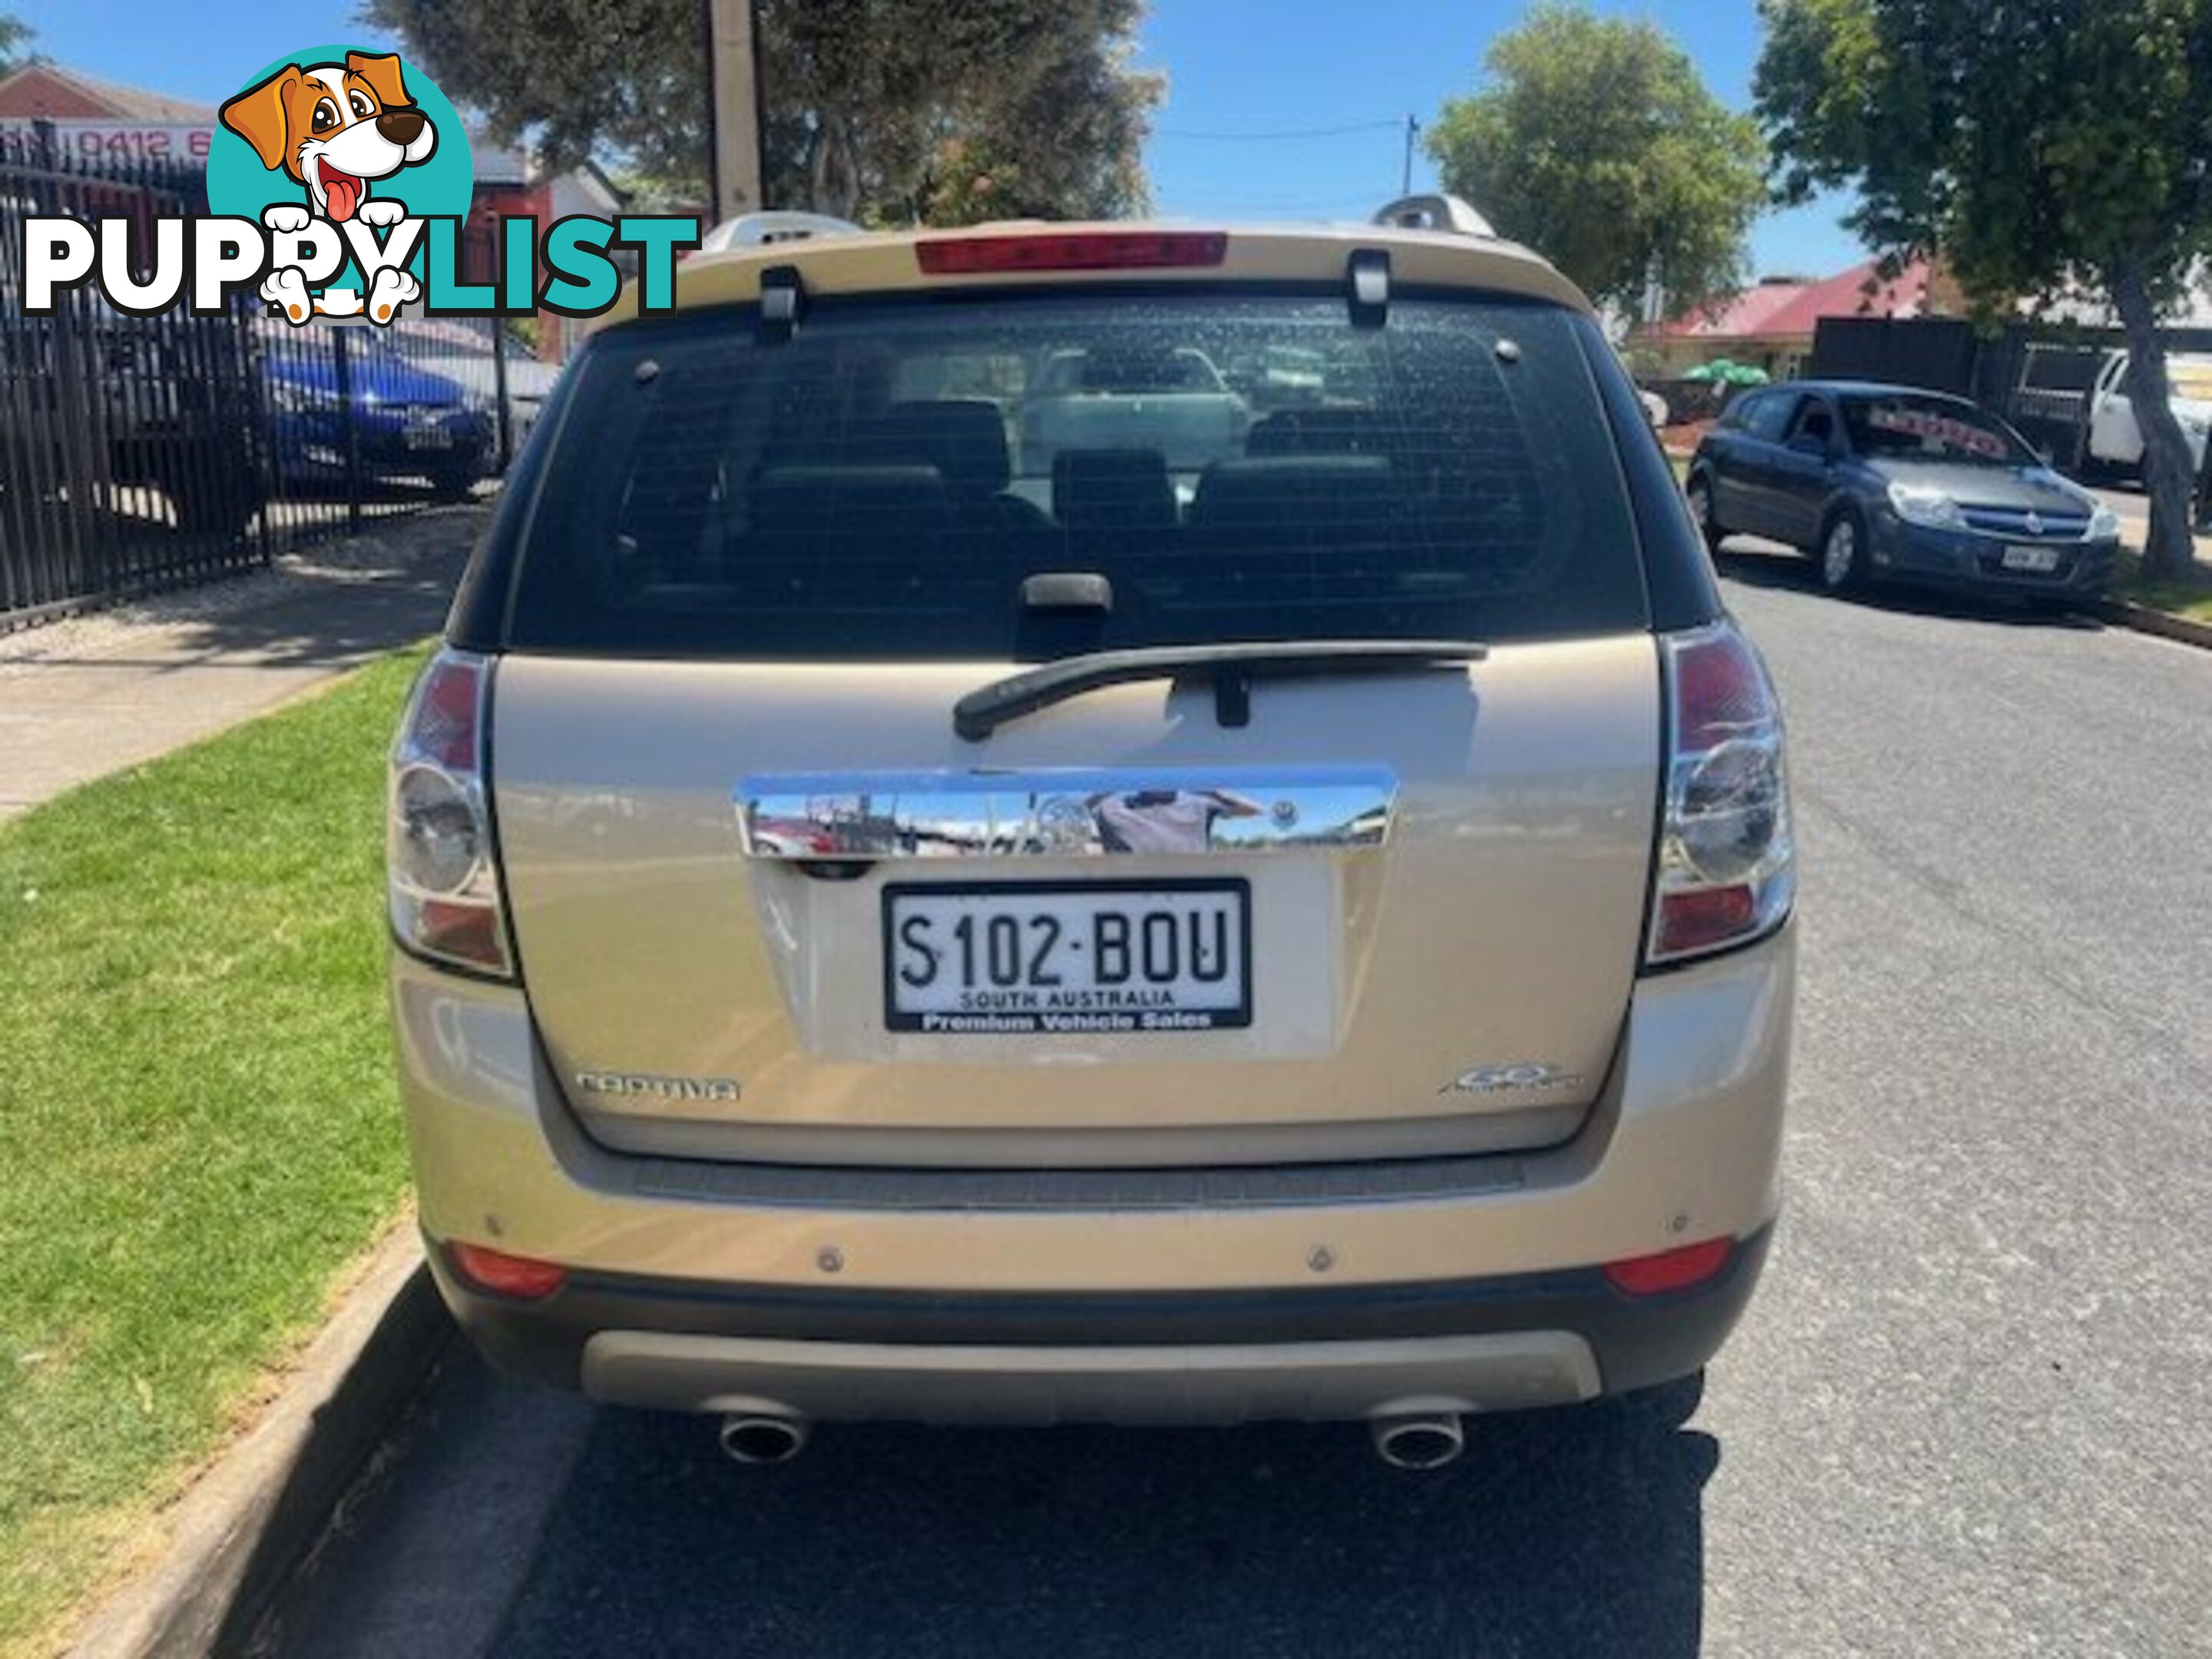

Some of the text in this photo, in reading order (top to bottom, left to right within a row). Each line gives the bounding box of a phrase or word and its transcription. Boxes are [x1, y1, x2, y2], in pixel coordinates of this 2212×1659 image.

[960, 990, 1175, 1008] SOUTH AUSTRALIA
[923, 1011, 1211, 1031] Premium Vehicle Sales
